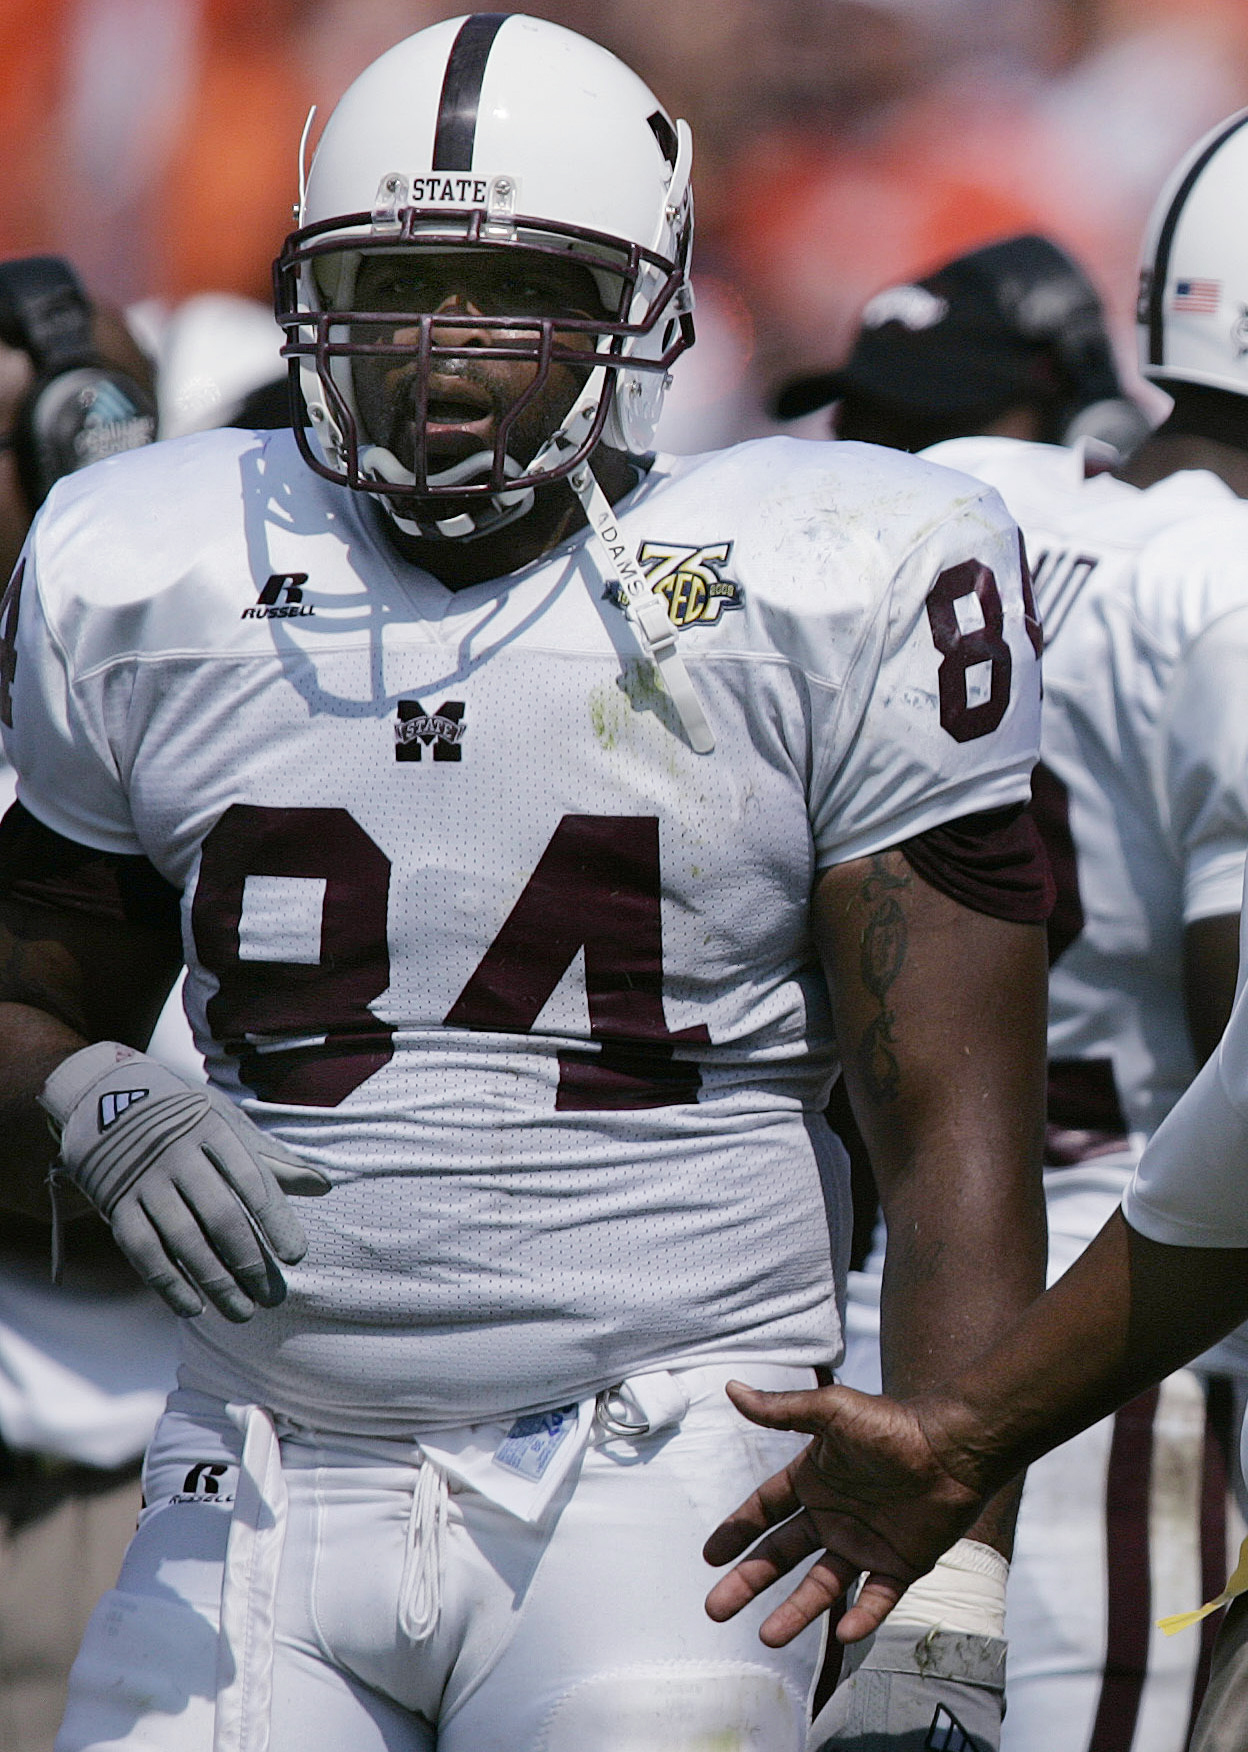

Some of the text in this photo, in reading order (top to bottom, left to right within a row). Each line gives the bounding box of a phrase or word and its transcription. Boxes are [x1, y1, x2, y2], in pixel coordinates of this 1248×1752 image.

[412, 178, 487, 203] STATE
[598, 512, 644, 596] ADAMS
[256, 572, 309, 605] R
[640, 541, 730, 620] 75
[241, 605, 315, 620] RUSSELL
[405, 718, 453, 738] STATE
[192, 804, 712, 1111] 84
